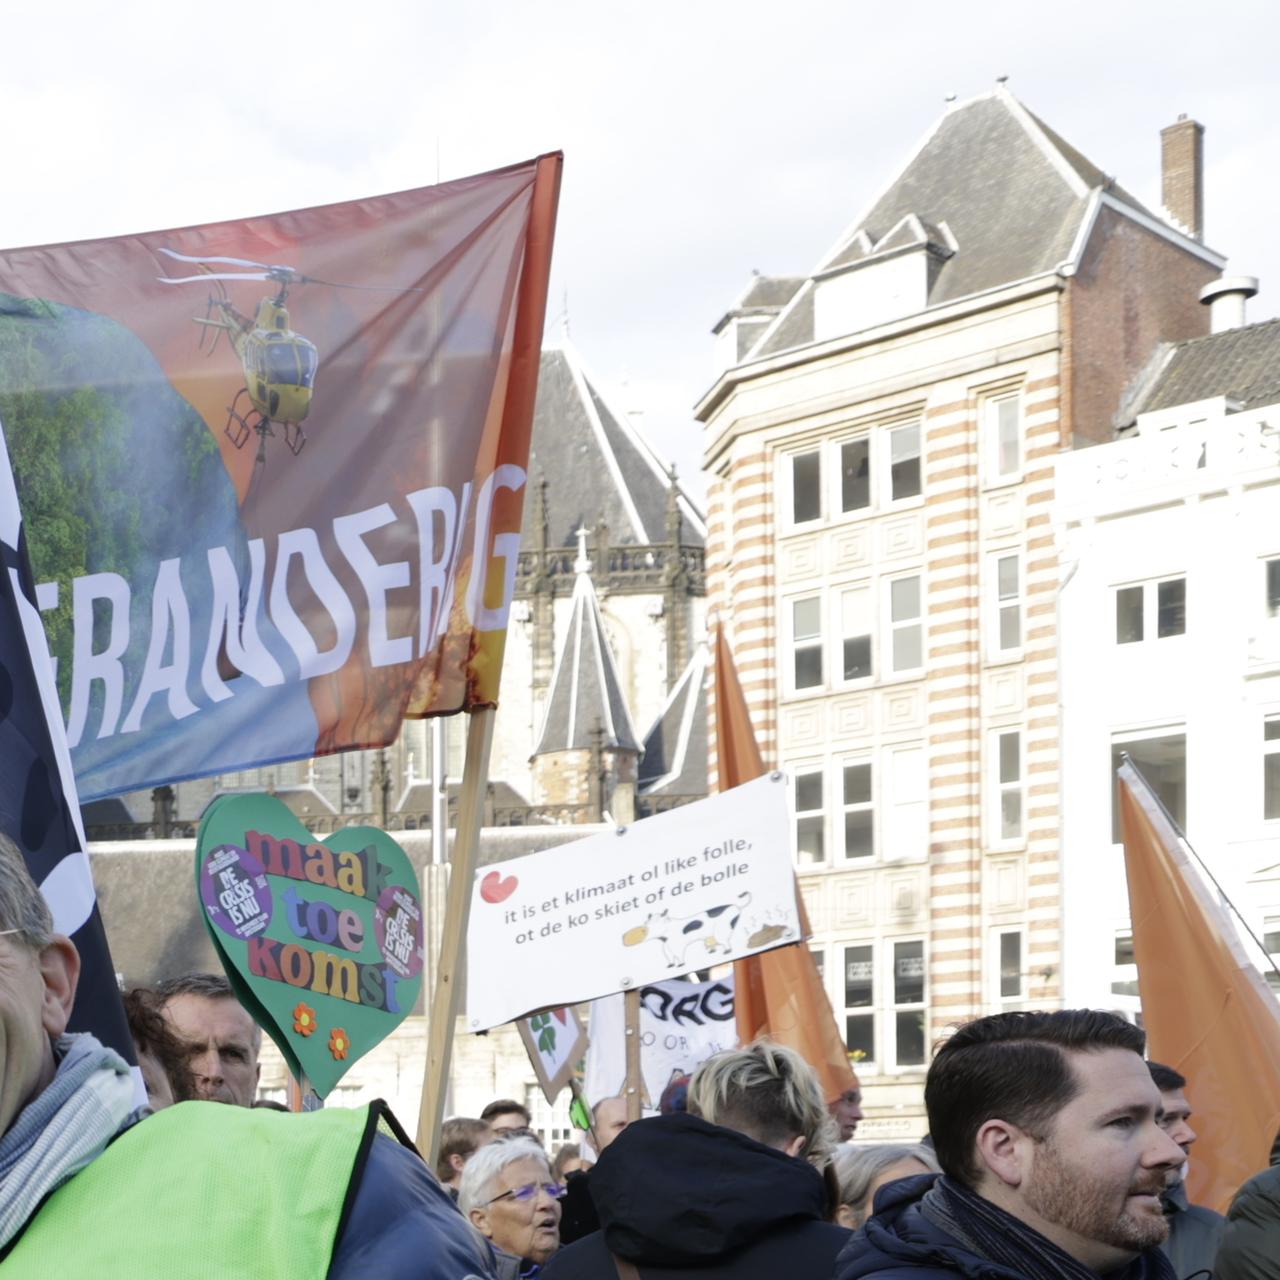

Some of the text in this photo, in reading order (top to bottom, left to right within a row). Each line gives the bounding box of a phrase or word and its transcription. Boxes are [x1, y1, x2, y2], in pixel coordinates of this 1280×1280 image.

[219, 867, 239, 890] DE
[220, 879, 254, 909] CRISIS
[244, 829, 393, 903] maak
[504, 838, 753, 924] it is et klimaat ol like folle,
[228, 906, 243, 925] IS
[240, 896, 260, 919] NU
[281, 886, 364, 953] toe
[515, 861, 750, 945] ot de ko skiet of de bolle
[247, 935, 402, 1014] komst
